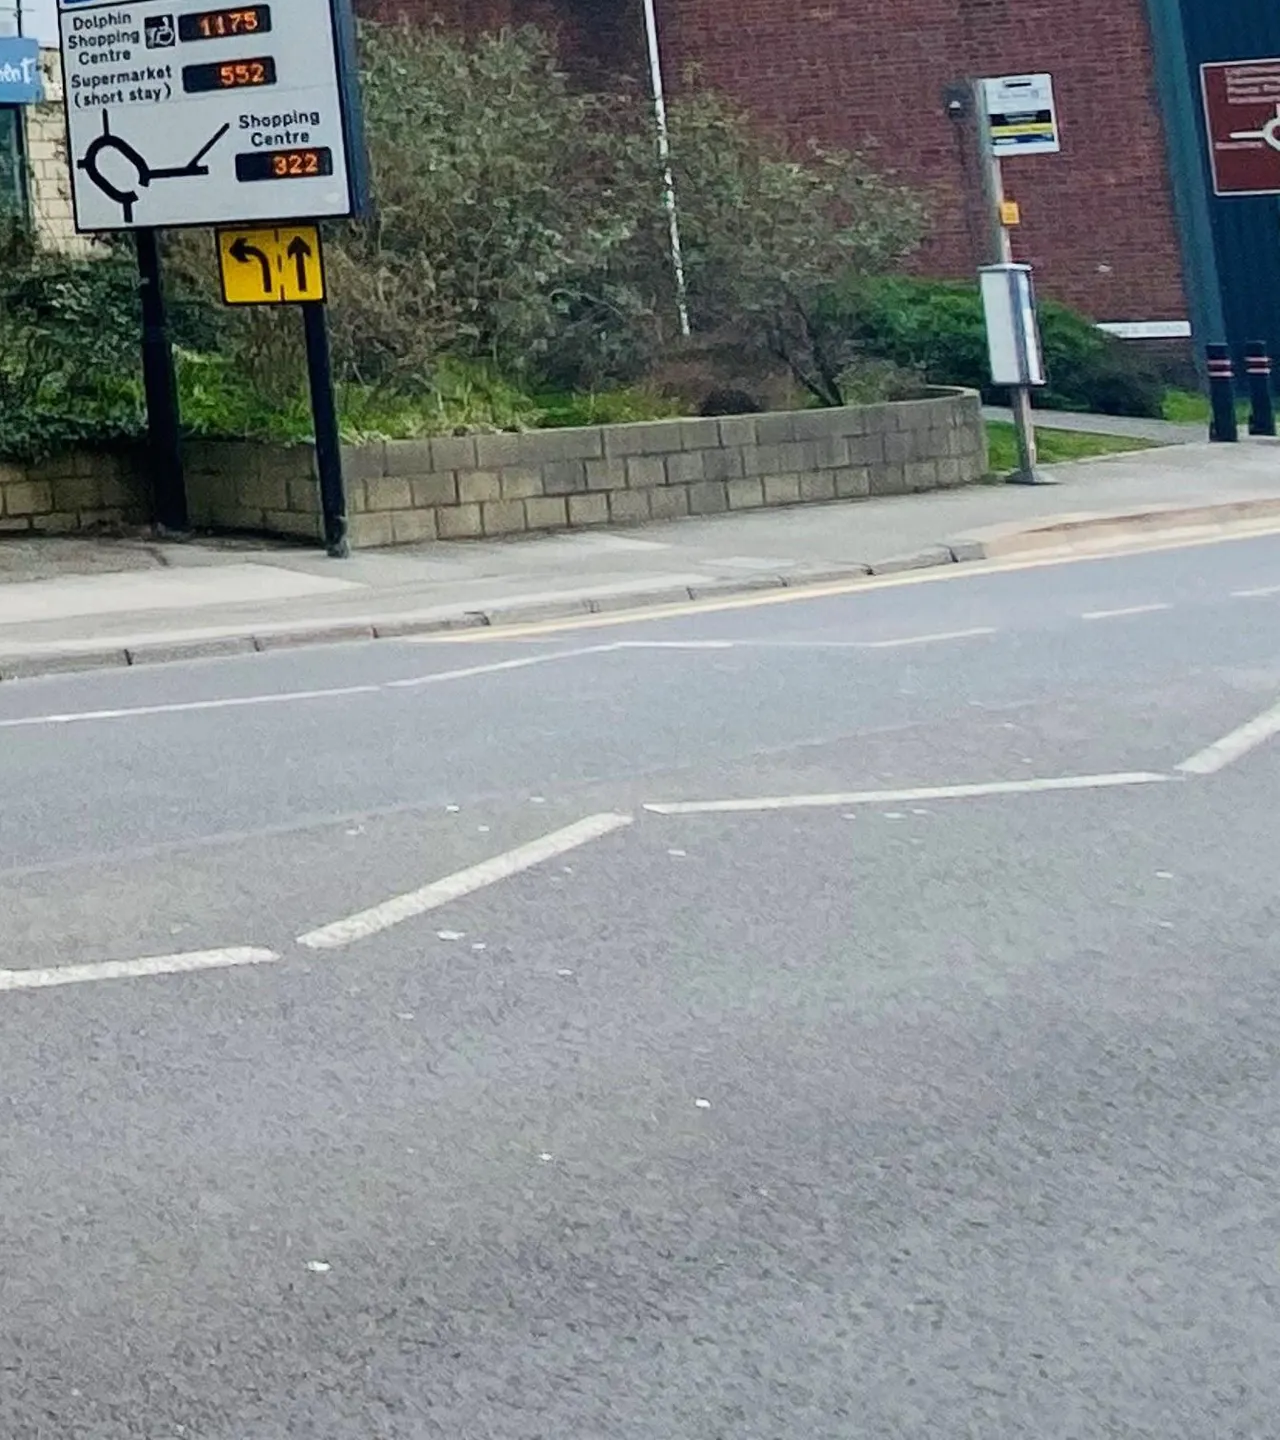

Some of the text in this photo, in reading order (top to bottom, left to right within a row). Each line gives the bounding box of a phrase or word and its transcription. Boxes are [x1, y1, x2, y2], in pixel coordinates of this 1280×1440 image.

[72, 11, 132, 31] Dolphin
[200, 10, 259, 36] 1175
[68, 28, 140, 49] Shopping
[78, 49, 132, 65] Centre
[71, 64, 172, 89] Supermarket
[220, 63, 265, 85] 552
[74, 83, 172, 109] (short stay)
[239, 109, 320, 129] Shopping
[251, 131, 309, 147] Centre
[274, 152, 318, 175] 322
